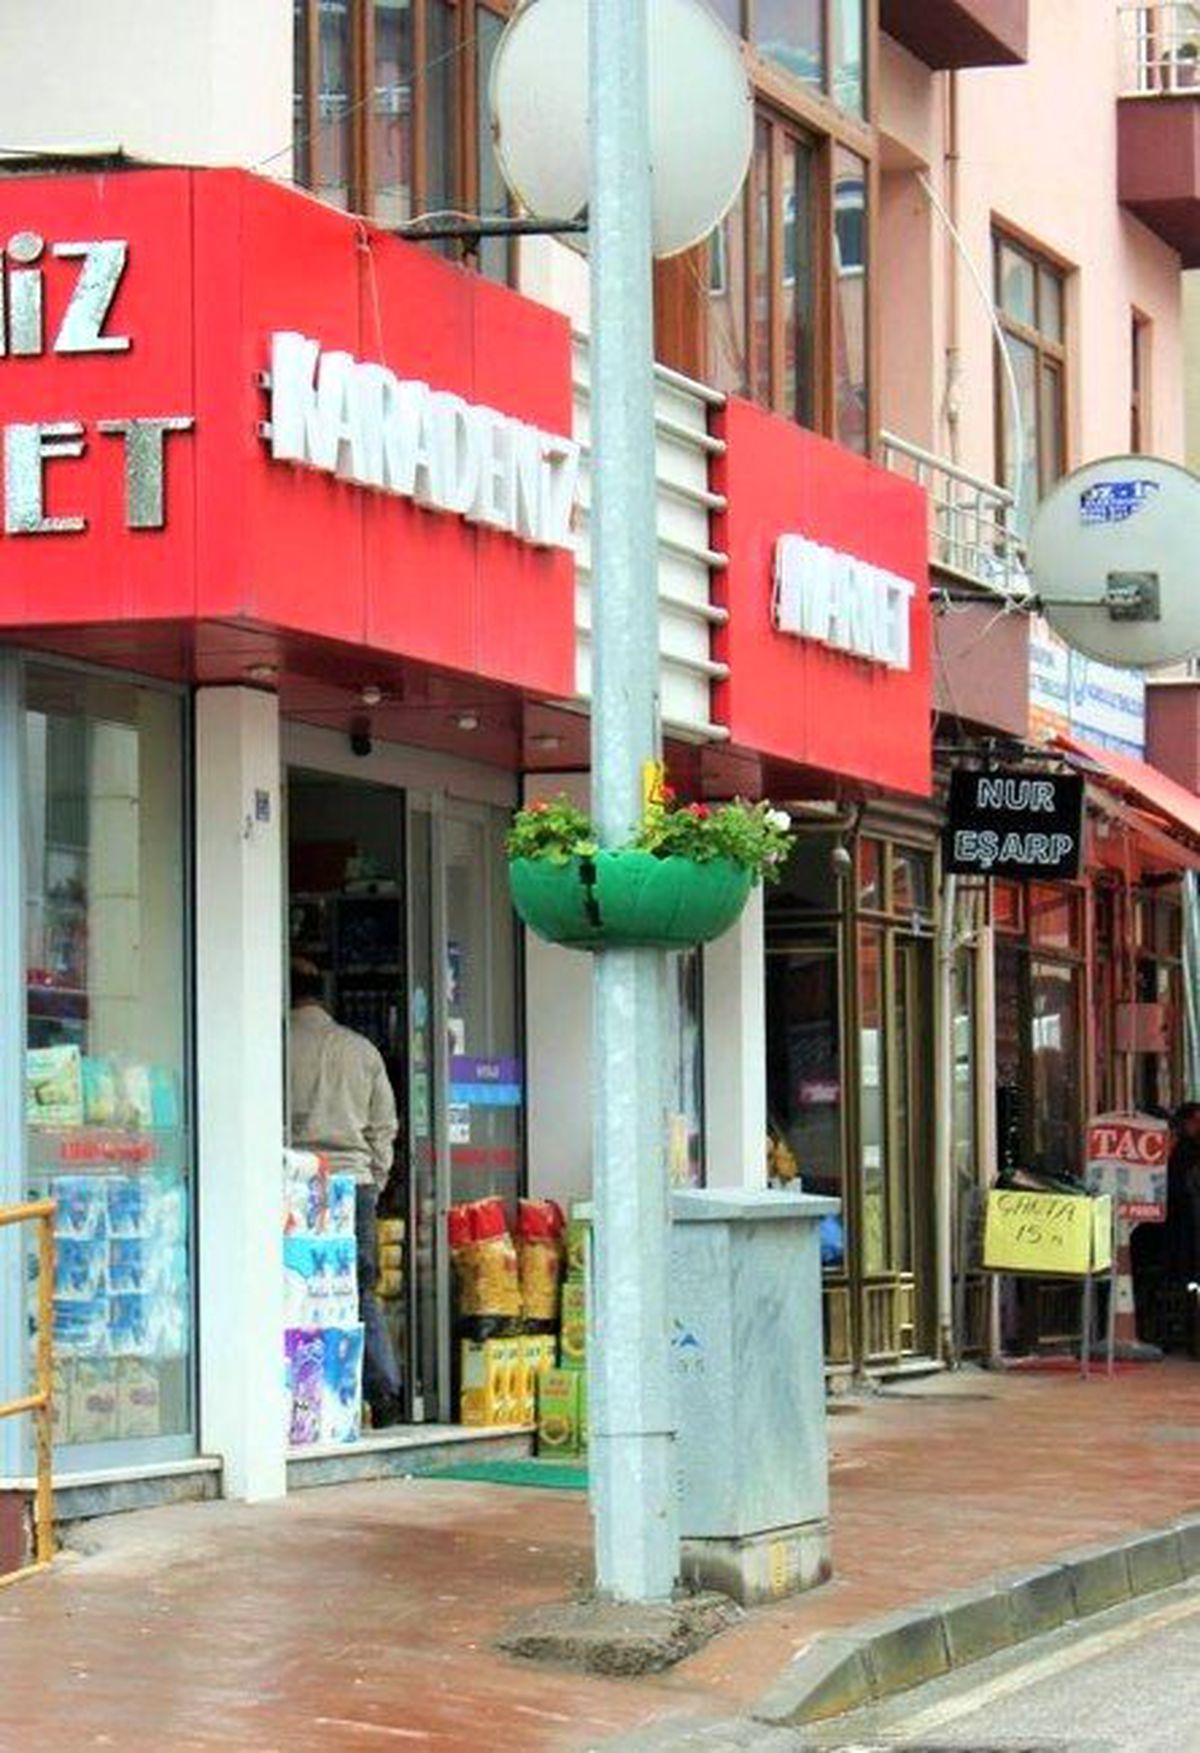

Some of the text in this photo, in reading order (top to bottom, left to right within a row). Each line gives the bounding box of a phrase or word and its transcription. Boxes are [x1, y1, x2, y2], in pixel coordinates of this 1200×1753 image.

[977, 777, 1056, 812] NUR
[953, 829, 1074, 869] EŞARP
[1092, 1128, 1164, 1161] TAC
